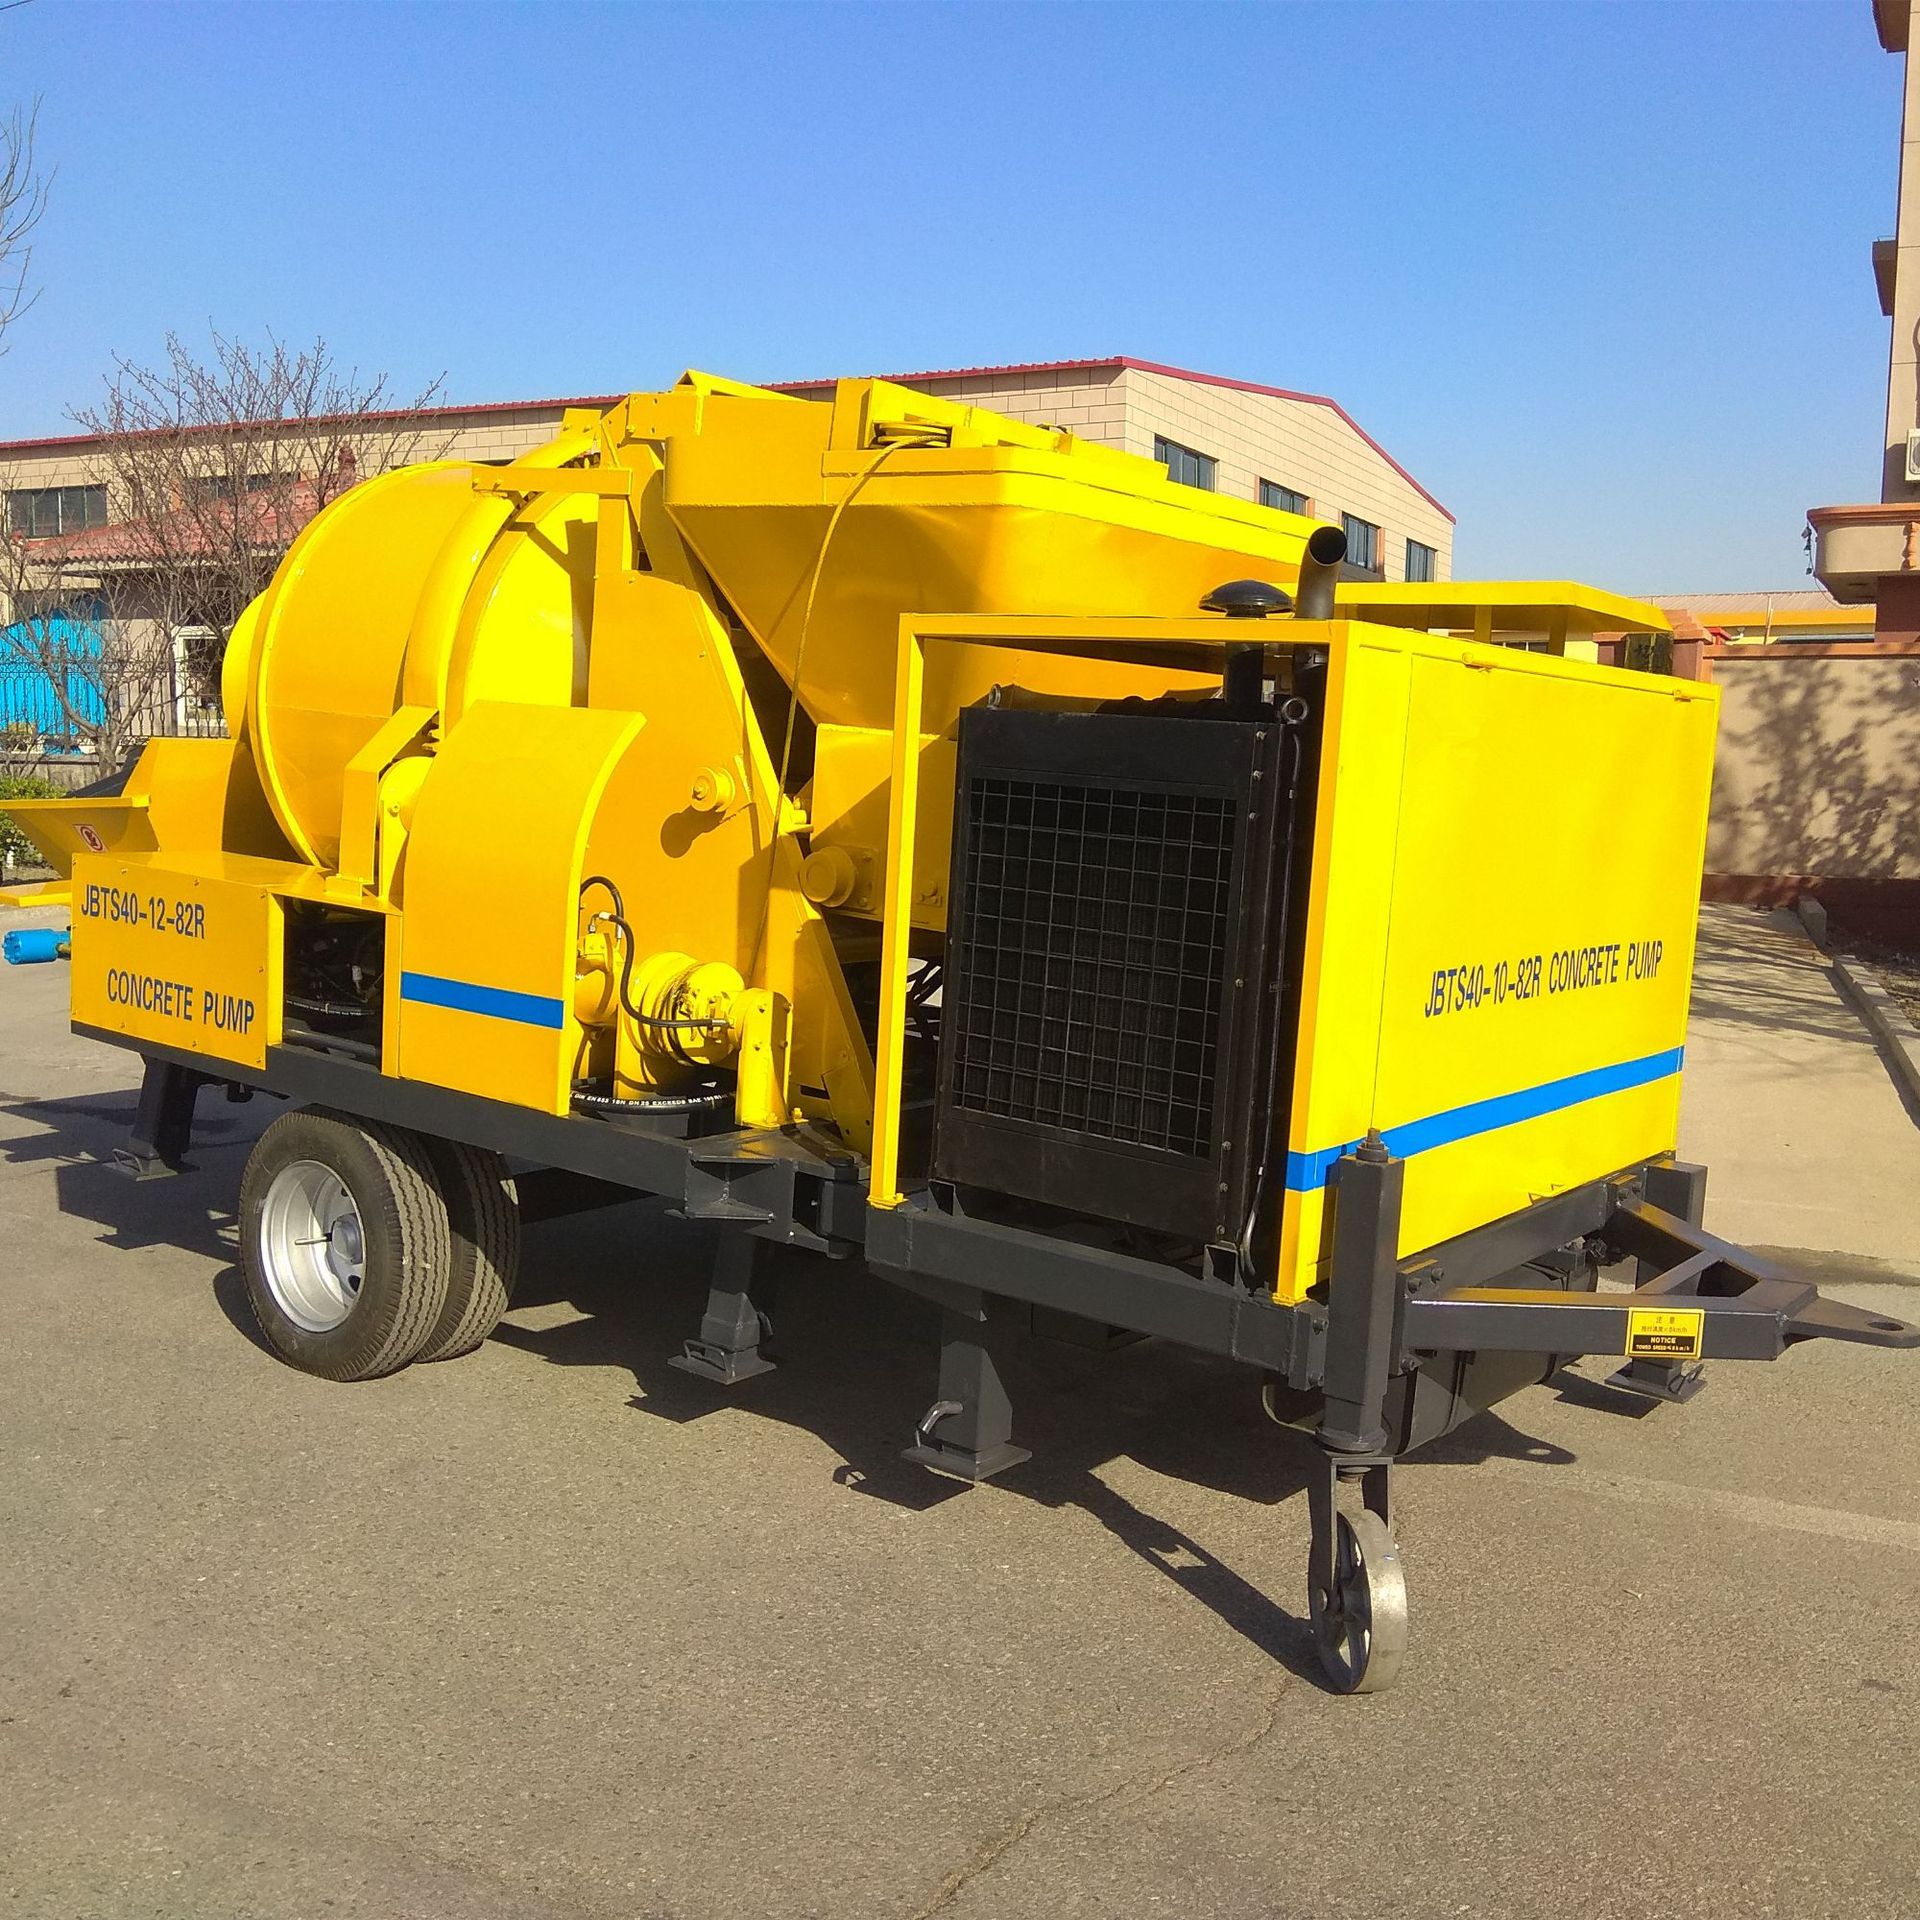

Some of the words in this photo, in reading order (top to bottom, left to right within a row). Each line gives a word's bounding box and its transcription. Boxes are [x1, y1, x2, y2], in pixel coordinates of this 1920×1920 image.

[82, 885, 204, 938] JBTS40-12-82R
[108, 969, 192, 1020] CONCRETE
[204, 991, 254, 1034] PUMP
[1425, 956, 1541, 1017] JBTS40-10-82R
[1550, 945, 1620, 993] CONCRETE
[1627, 941, 1662, 979] PUMP
